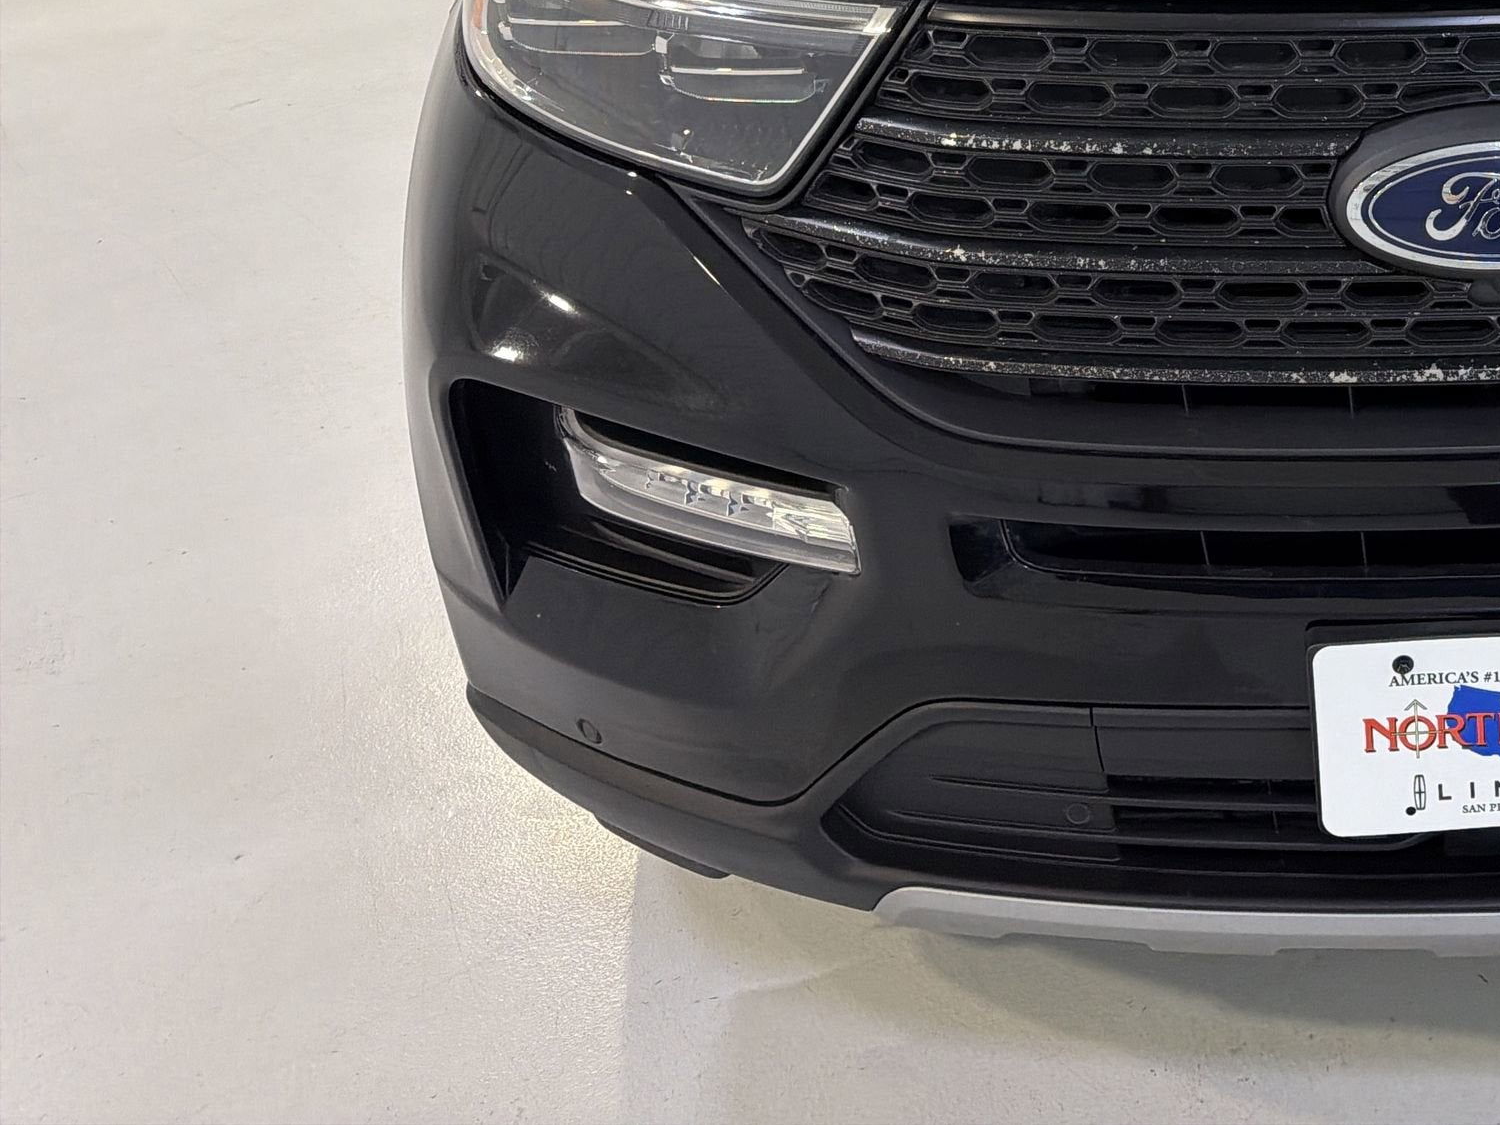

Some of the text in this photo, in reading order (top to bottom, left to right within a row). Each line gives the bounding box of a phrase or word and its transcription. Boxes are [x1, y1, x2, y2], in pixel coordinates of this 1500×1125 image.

[1388, 670, 1479, 687] AMERICA'S
[1483, 672, 1500, 683] #1
[1461, 803, 1487, 814] SAN
